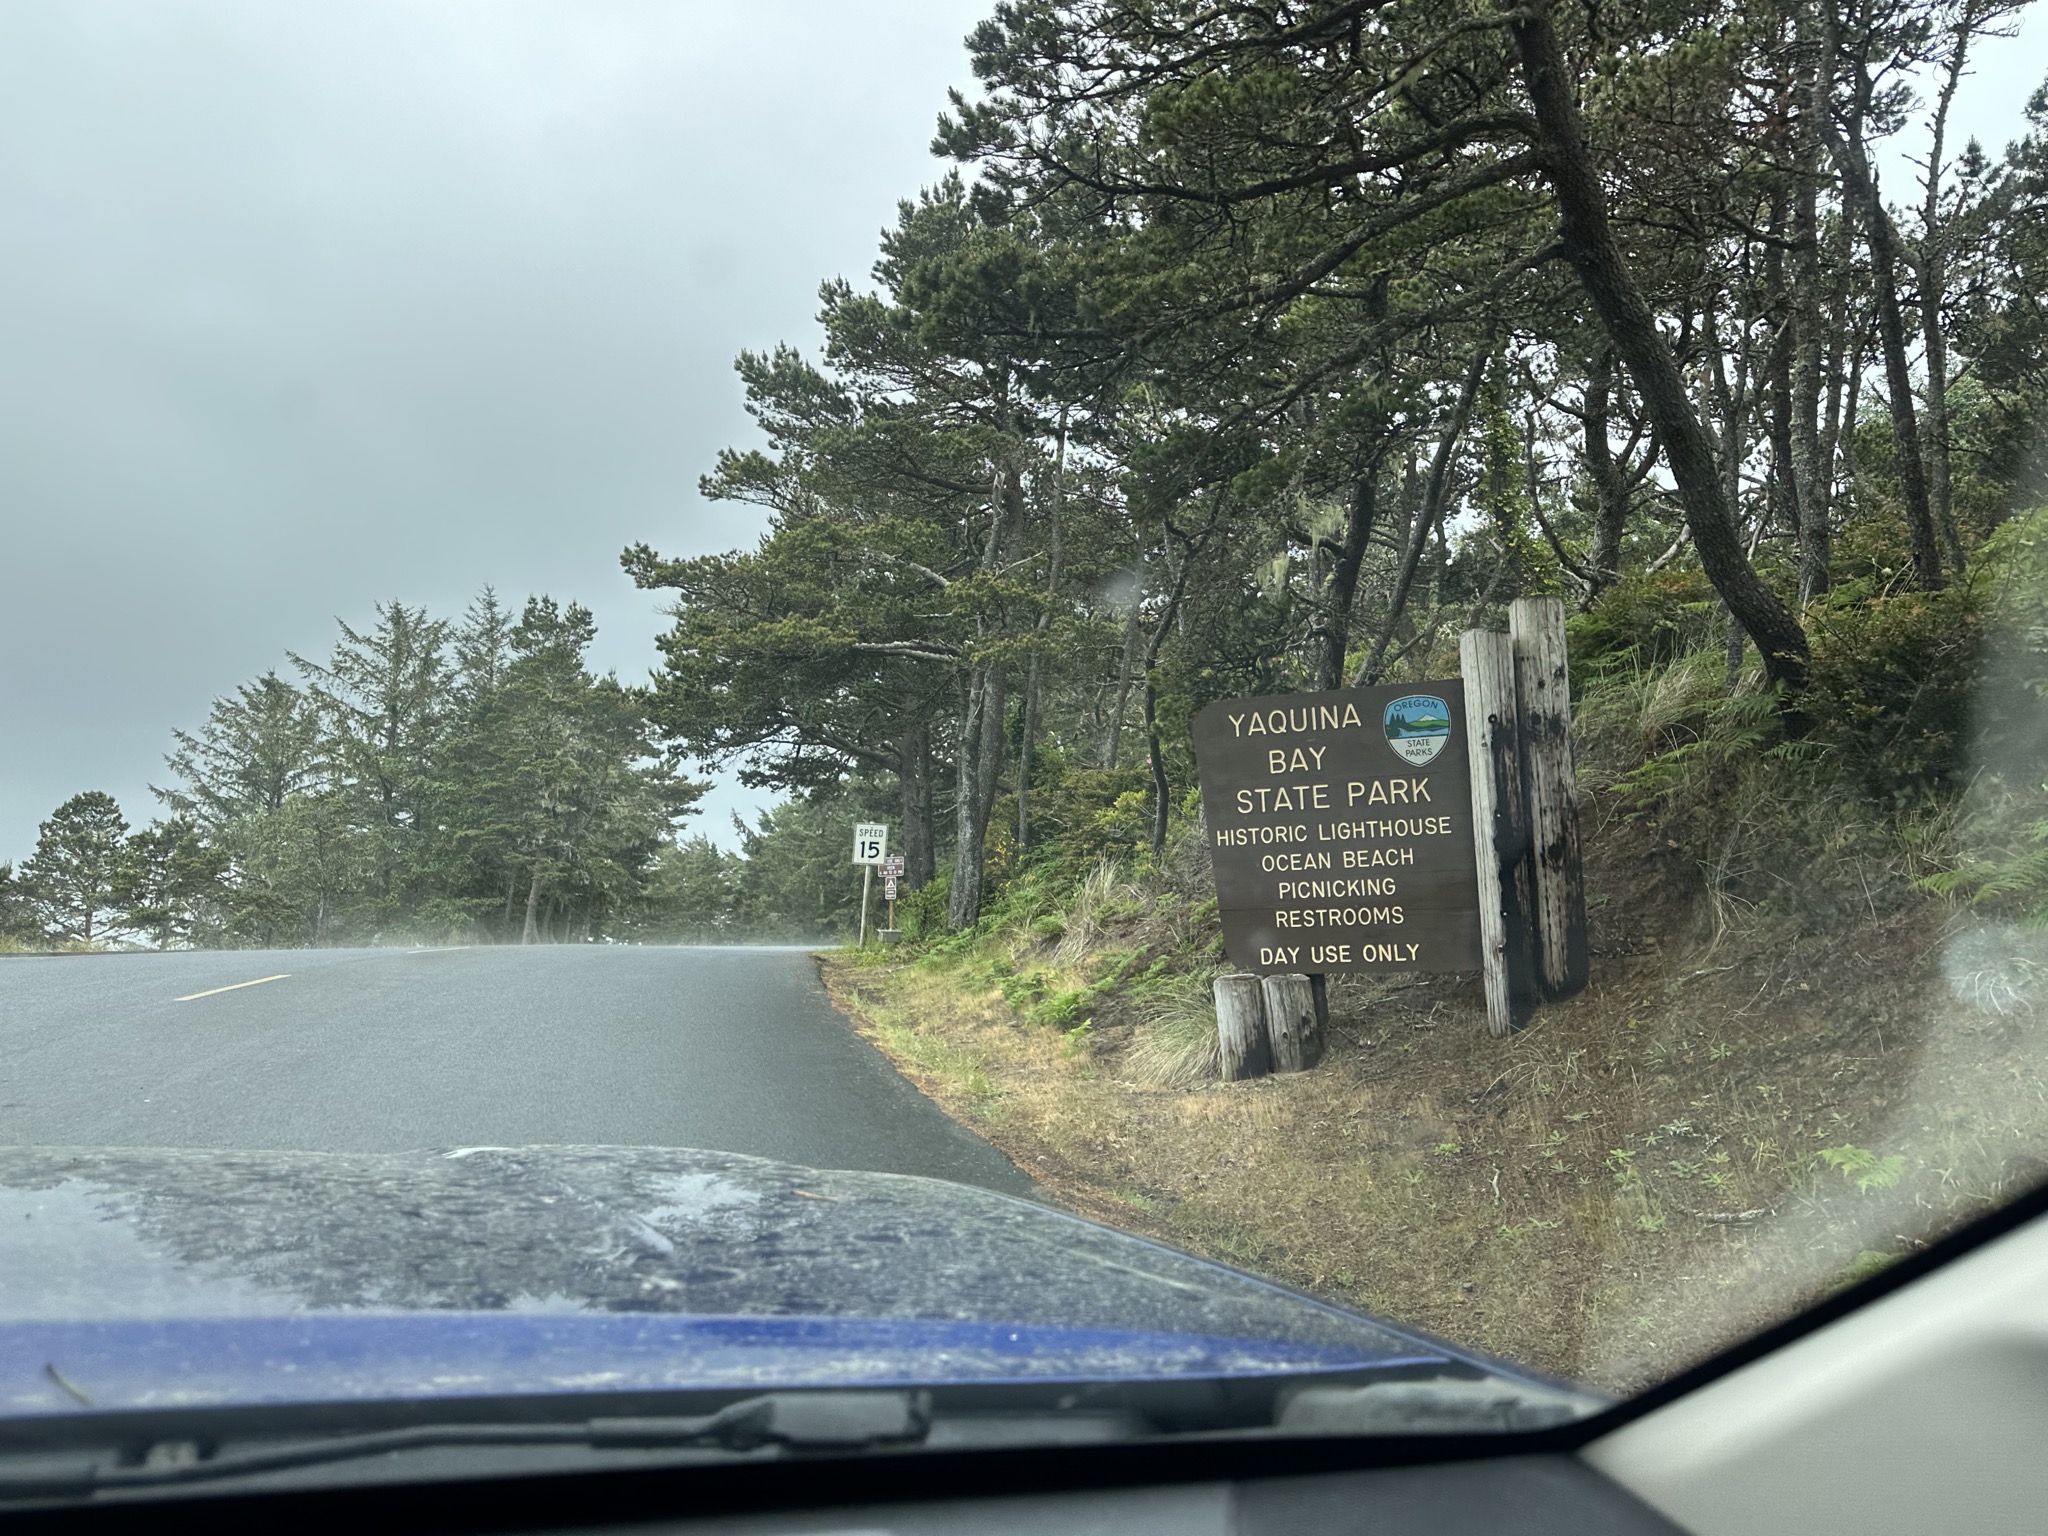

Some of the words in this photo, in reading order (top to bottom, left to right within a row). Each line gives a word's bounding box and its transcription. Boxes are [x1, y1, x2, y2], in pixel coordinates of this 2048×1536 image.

[1394, 699, 1438, 711] OREGON
[1228, 703, 1362, 738] YAQUINA
[1406, 748, 1432, 757] PARKS
[1407, 739, 1430, 747] STATE
[1268, 746, 1326, 774] BAY
[1236, 784, 1330, 814] STATE
[1347, 778, 1432, 807] PARK
[859, 829, 883, 837] SPEED
[1216, 825, 1308, 846] HISTORIC
[1318, 816, 1452, 841] LIGHTHOUSE
[861, 841, 879, 858] 15
[1261, 853, 1331, 872] OCEAN
[1343, 848, 1414, 868] BEACH
[1279, 878, 1396, 899] PICNICKING
[1275, 907, 1404, 928] RESTROOMS
[1260, 947, 1300, 965] DAY
[1311, 945, 1352, 963] USE
[1363, 943, 1420, 962] ONLY
